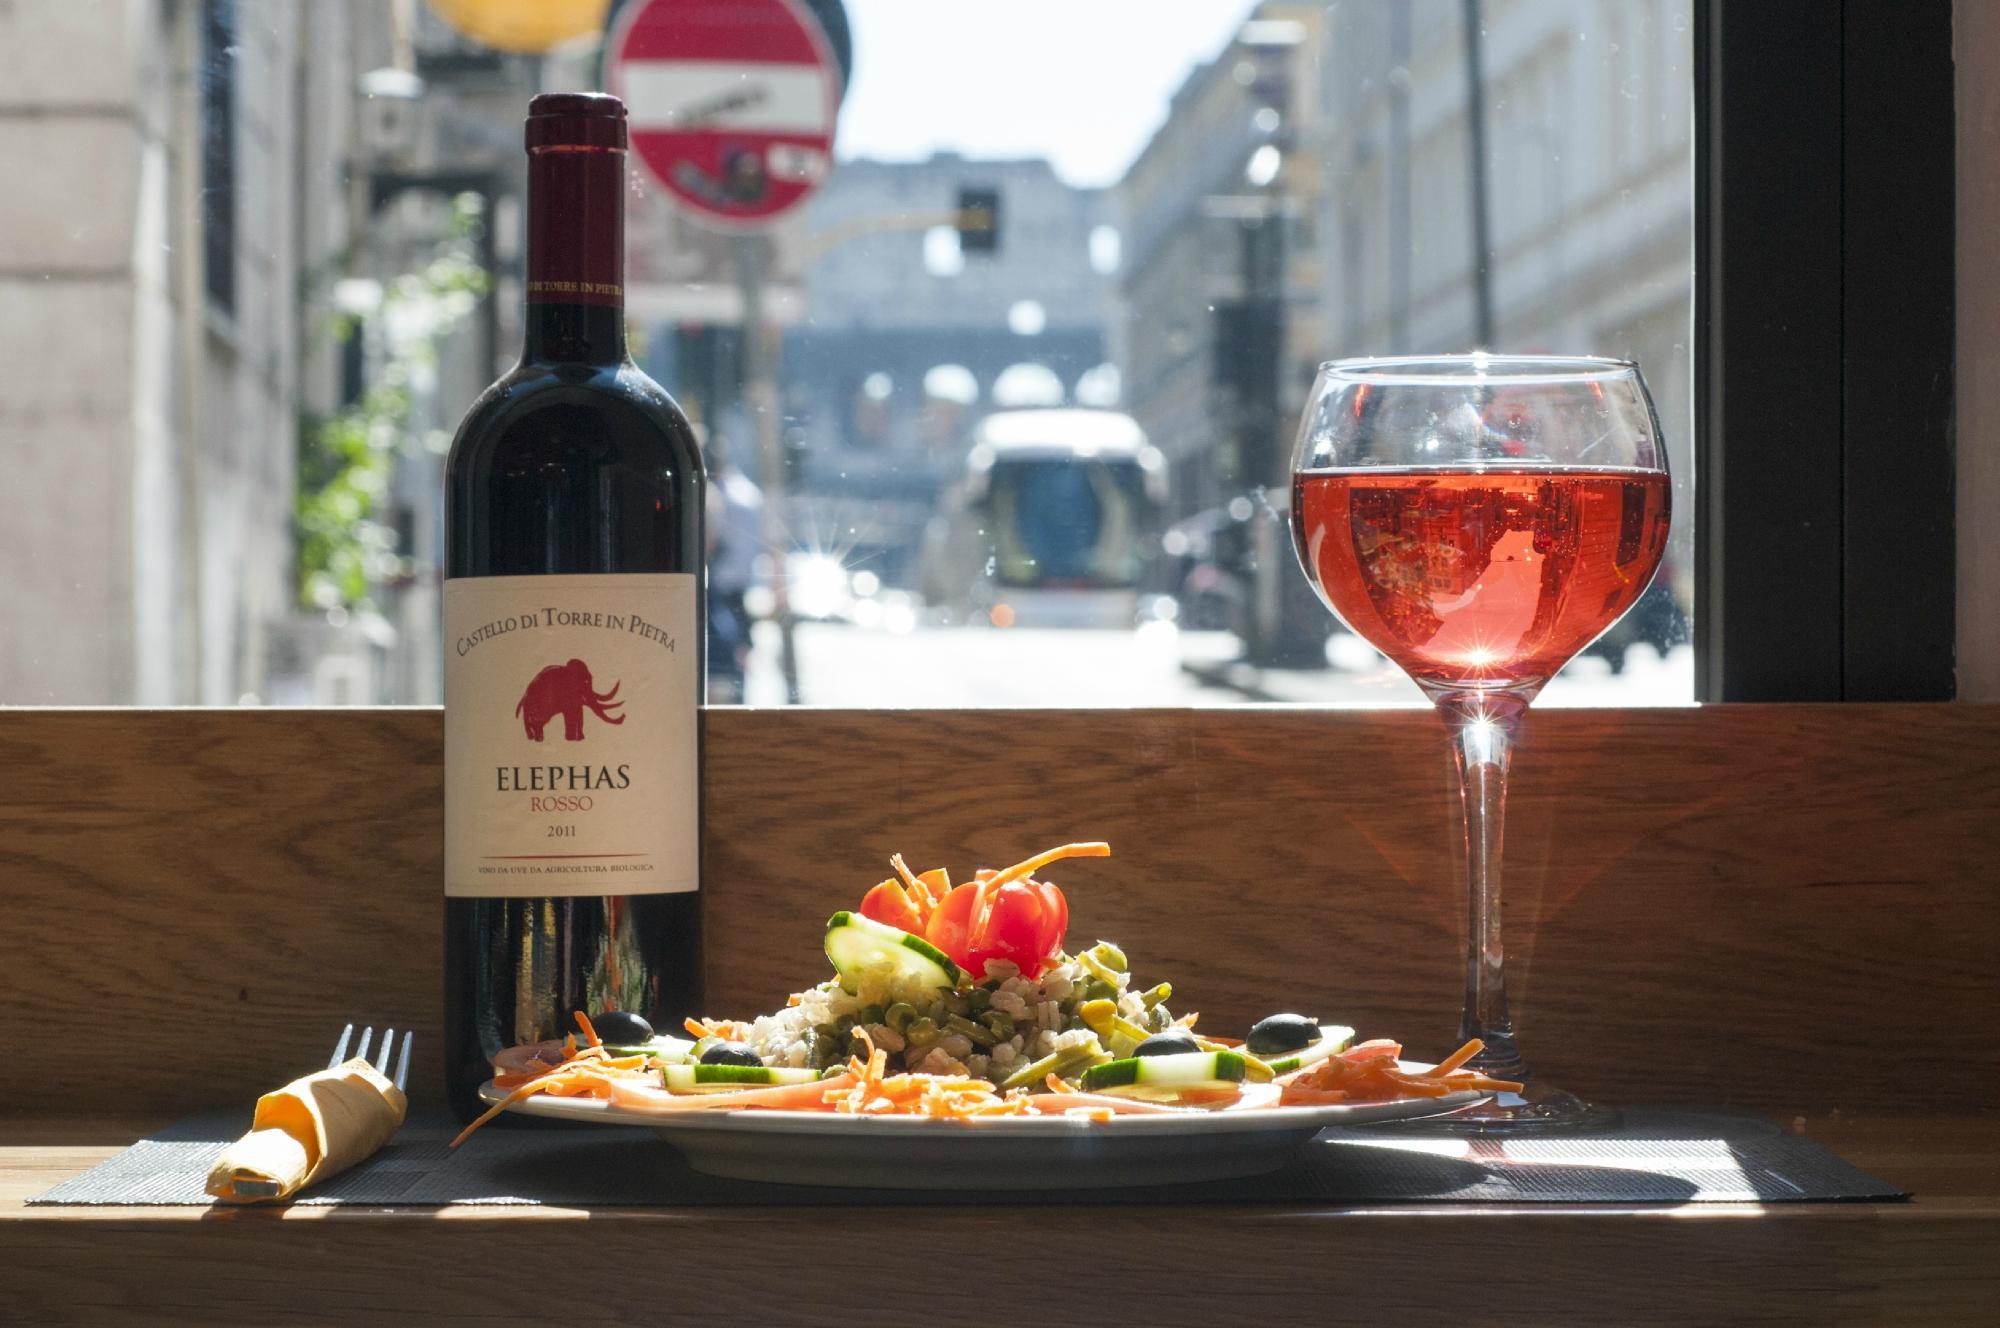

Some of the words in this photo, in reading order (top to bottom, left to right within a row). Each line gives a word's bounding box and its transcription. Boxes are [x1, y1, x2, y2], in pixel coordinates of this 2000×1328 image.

[543, 281, 578, 292] TORRE
[580, 282, 594, 294] IN
[456, 618, 517, 657] CASTELLO
[521, 614, 538, 629] DI
[541, 607, 602, 627] TORRE
[606, 615, 625, 630] IN
[628, 614, 676, 653] PIETRA
[496, 764, 631, 791] ELEPHAS
[531, 796, 593, 812] ROSSO
[547, 825, 576, 838] 2011
[544, 865, 608, 873] AGRICOLTURA
[610, 864, 654, 872] BIOLOGICA
